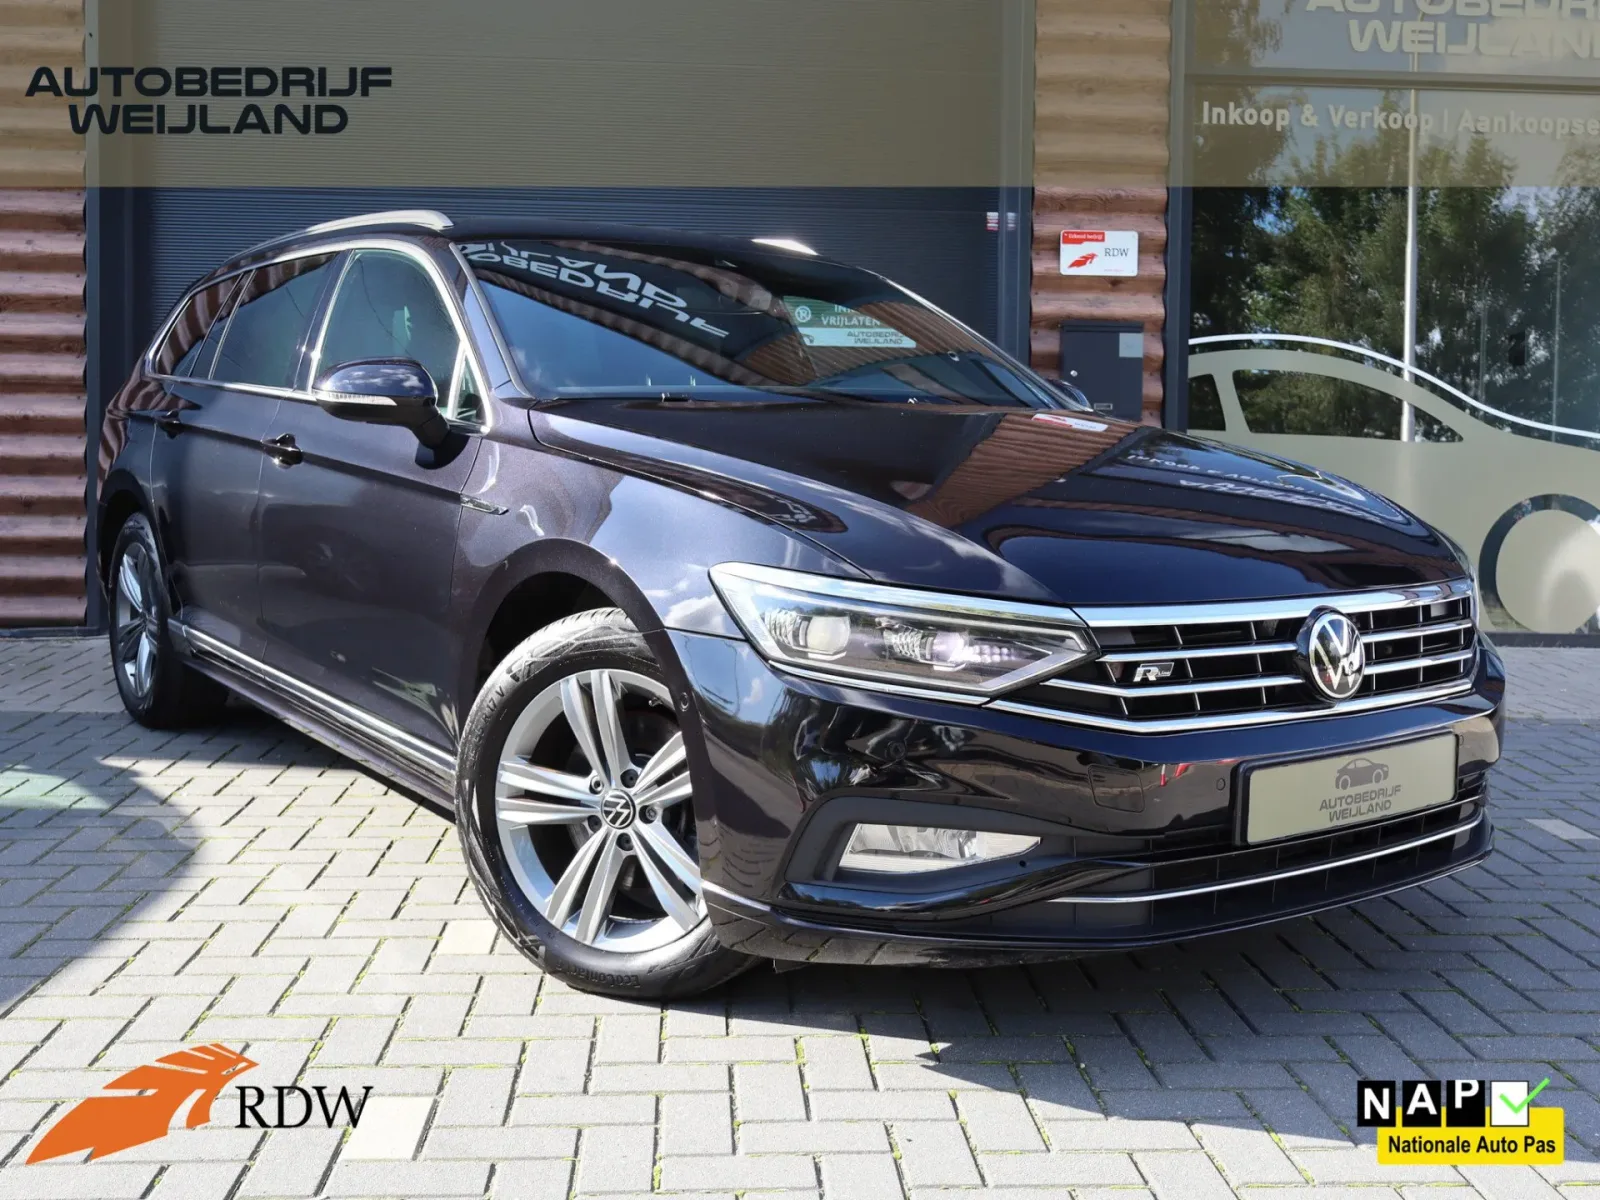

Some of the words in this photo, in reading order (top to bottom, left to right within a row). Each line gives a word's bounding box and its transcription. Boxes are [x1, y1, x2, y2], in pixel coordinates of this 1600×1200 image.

[1349, 19, 1600, 58] WEIJLAN
[1203, 101, 1290, 131] Inkoop
[1301, 104, 1318, 127] &
[1328, 105, 1434, 135] Verkoop
[1104, 248, 1129, 257] RDW
[1319, 784, 1402, 811] AUTOBEDRIJF
[1329, 800, 1392, 822] WEIJLAND
